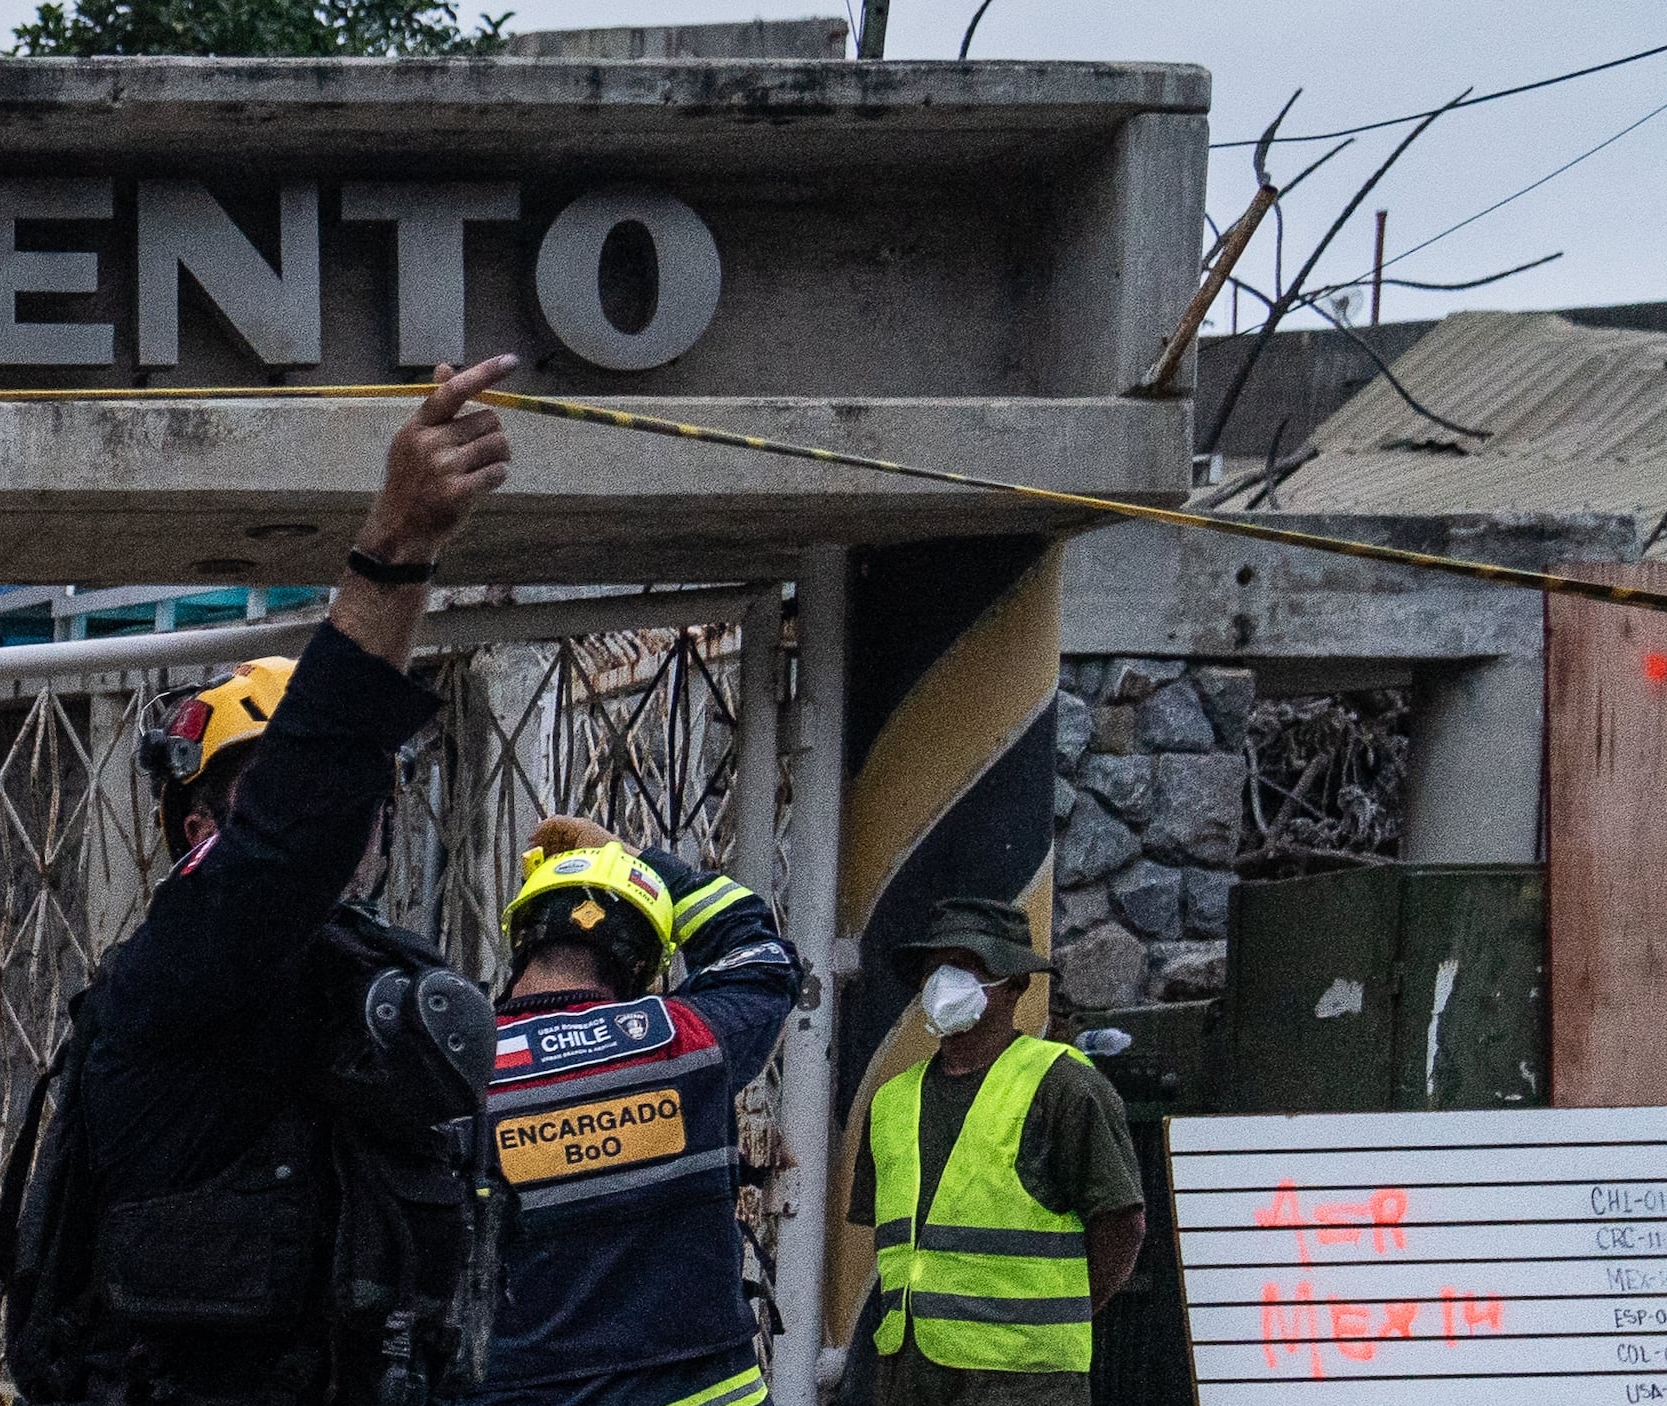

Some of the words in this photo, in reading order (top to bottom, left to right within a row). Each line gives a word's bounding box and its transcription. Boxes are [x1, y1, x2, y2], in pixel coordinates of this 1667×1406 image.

[538, 1025, 561, 1036] USAR
[540, 1025, 612, 1053] CHILE
[499, 1098, 678, 1150] ENCARGADO
[565, 1136, 622, 1164] BoO
[1261, 1281, 1419, 1381] MEX
